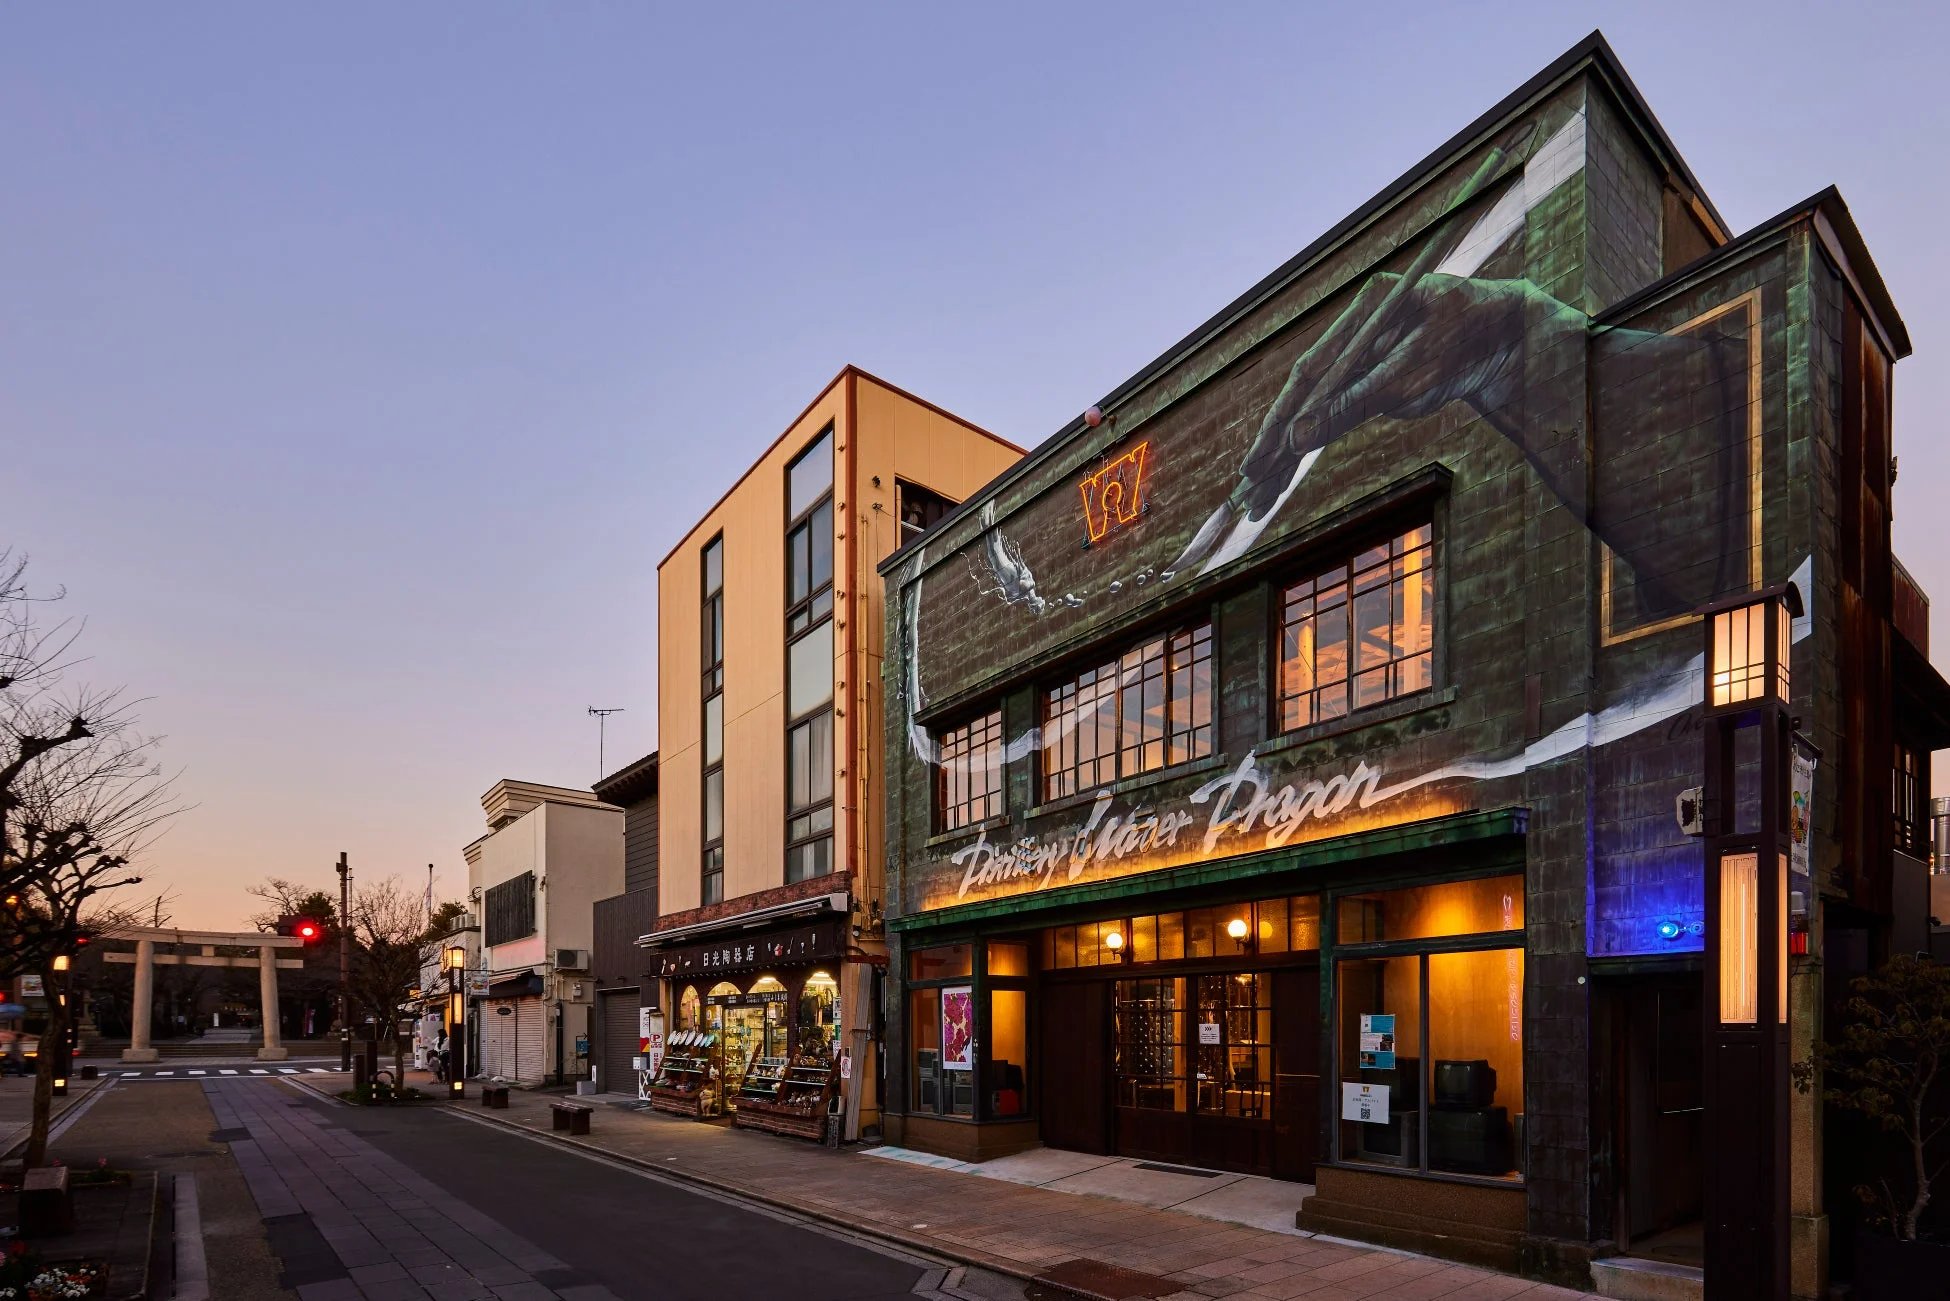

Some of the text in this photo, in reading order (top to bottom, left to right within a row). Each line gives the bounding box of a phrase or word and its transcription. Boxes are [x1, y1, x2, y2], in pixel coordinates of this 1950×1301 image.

[1188, 748, 1388, 855] Dragon
[703, 944, 755, 967] 日光陶器店
